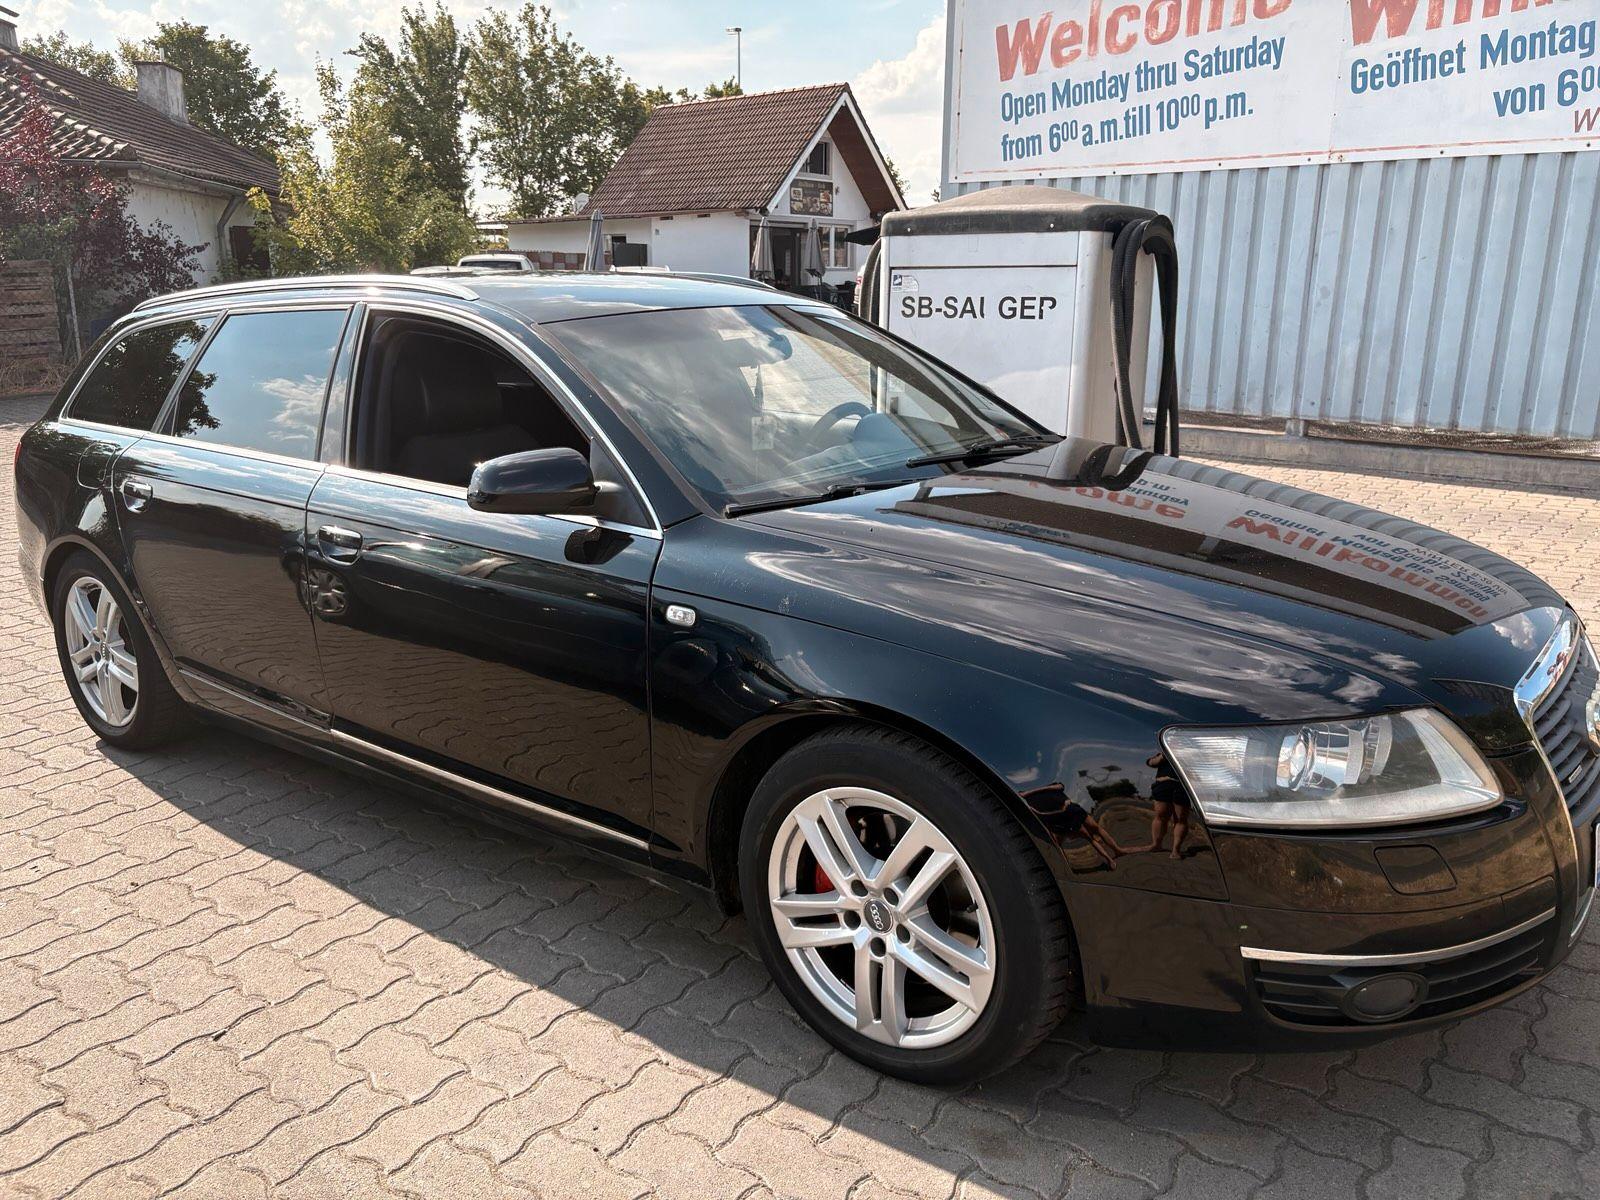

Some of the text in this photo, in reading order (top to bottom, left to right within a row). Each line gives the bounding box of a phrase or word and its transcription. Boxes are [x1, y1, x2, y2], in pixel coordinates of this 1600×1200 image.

[1001, 35, 1286, 124] Open Monday thru Saturday
[1351, 39, 1466, 94] Geöffnet
[1480, 20, 1596, 69] Montag
[1493, 65, 1600, 117] von 60
[1001, 134, 1042, 161] from
[1205, 91, 1254, 129] p.m.
